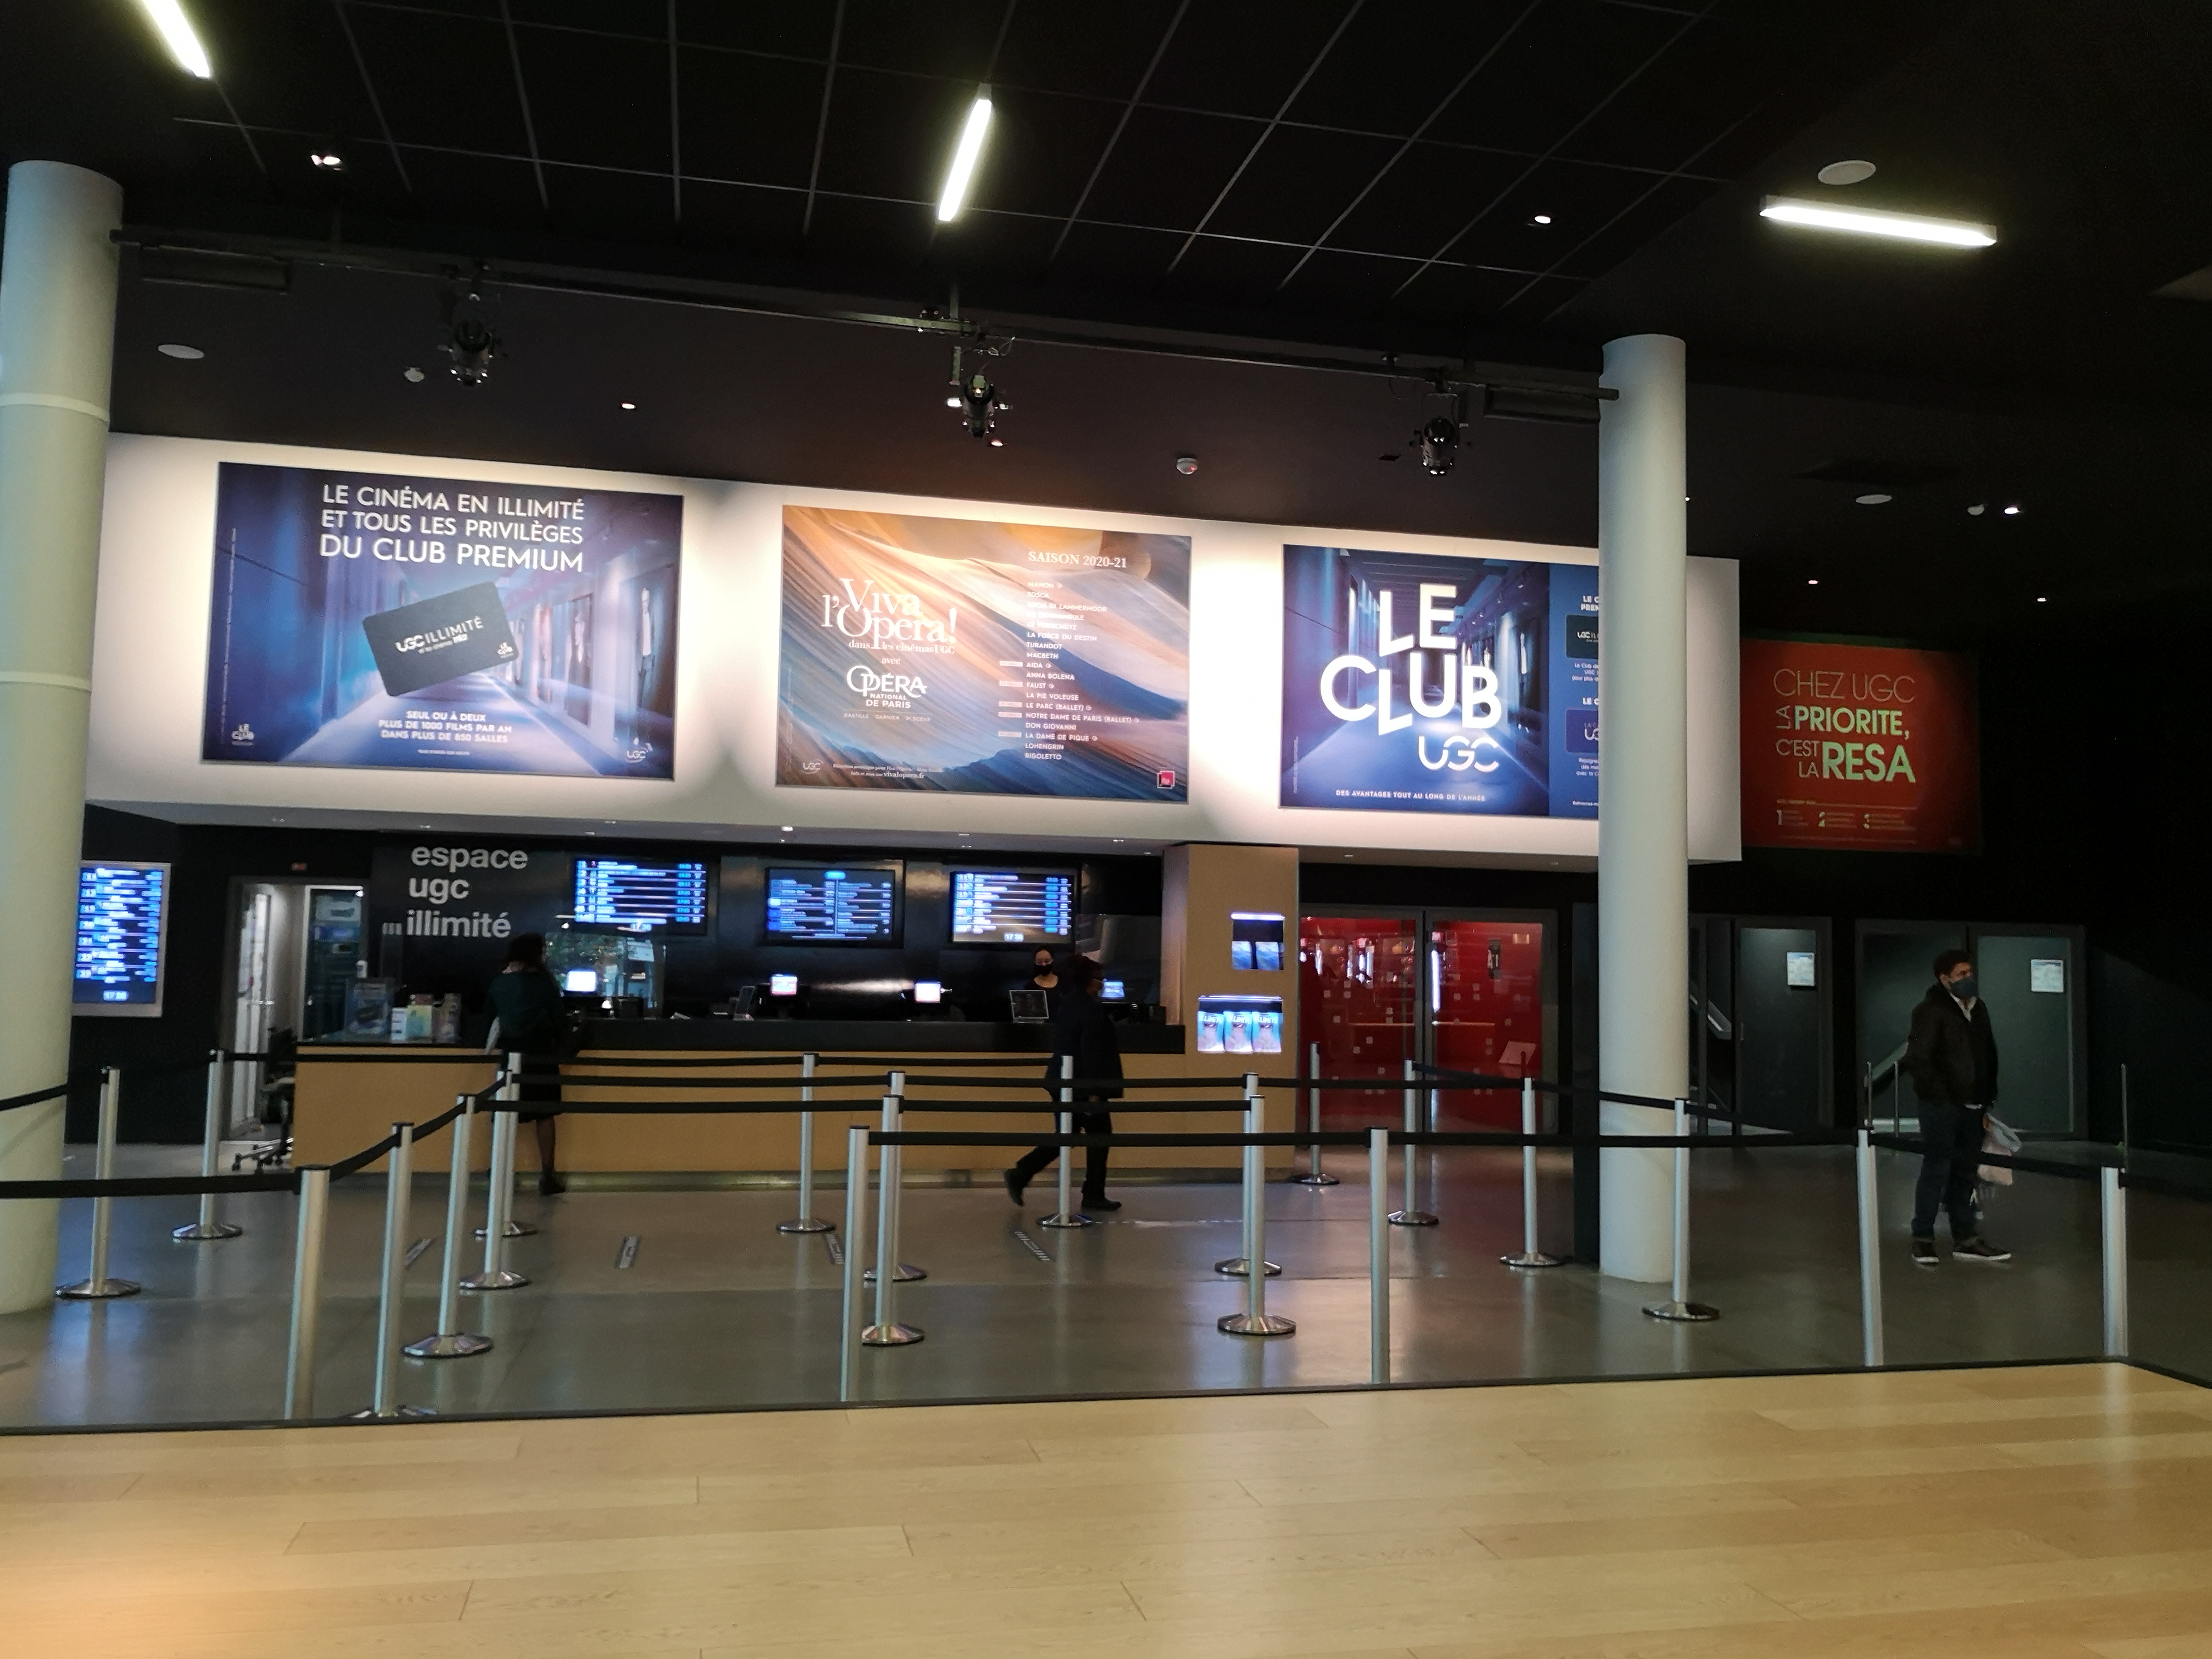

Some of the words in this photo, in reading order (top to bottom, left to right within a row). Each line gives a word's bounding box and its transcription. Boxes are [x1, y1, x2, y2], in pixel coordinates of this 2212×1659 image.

[323, 483, 349, 505] LE
[356, 486, 450, 511] CINÉMA
[457, 493, 488, 514] EN
[497, 497, 584, 521] ILLIMITÉ
[321, 509, 348, 529] ET
[352, 511, 412, 533] TOUS
[419, 515, 457, 536] LES
[465, 520, 584, 545] PRIVILÈGES
[319, 533, 362, 559] DU
[372, 536, 446, 564] CLUB
[457, 542, 584, 573] PREMIUM
[1028, 551, 1081, 565] SAISON
[1083, 555, 1127, 569] 2020-21
[840, 578, 923, 616] Viva
[1379, 583, 1458, 658] LE
[394, 634, 425, 653] UGC
[423, 615, 484, 645] ILLIMITÉ
[848, 639, 871, 649] dans
[882, 641, 894, 651] les
[895, 642, 934, 653] cinémas
[934, 644, 955, 654] UGC
[881, 657, 901, 665] avec
[846, 664, 928, 698] OPÉRA
[1320, 649, 1503, 737] CLUB
[1773, 668, 1846, 700] CHEZ
[1852, 673, 1916, 704] UGC
[405, 710, 429, 720] SEUL
[431, 711, 448, 721] OU
[459, 712, 486, 722] DEUX
[882, 700, 911, 709] PARIS
[1056, 703, 1084, 711] (BALLET)
[1776, 705, 1792, 730] LA
[378, 719, 403, 729] PLUS
[404, 720, 419, 730] DE
[445, 722, 473, 731] FILMS
[476, 724, 495, 733] PAR
[497, 724, 512, 733] AN
[1104, 716, 1132, 724] (BALLET)
[380, 729, 409, 739] DANS
[411, 730, 435, 740] PLUS
[438, 731, 452, 741] DE
[474, 733, 508, 743] SALLES
[627, 750, 647, 759] UGC
[803, 761, 821, 770] UGC
[1418, 734, 1500, 773] UGC
[1776, 738, 1820, 758] C'EST
[1822, 741, 1917, 783] RESA
[1798, 760, 1820, 779] LA
[1351, 790, 1391, 798] AVANTAGES
[410, 846, 529, 874] espace
[409, 877, 469, 905] ugc
[406, 909, 512, 938] illimité
